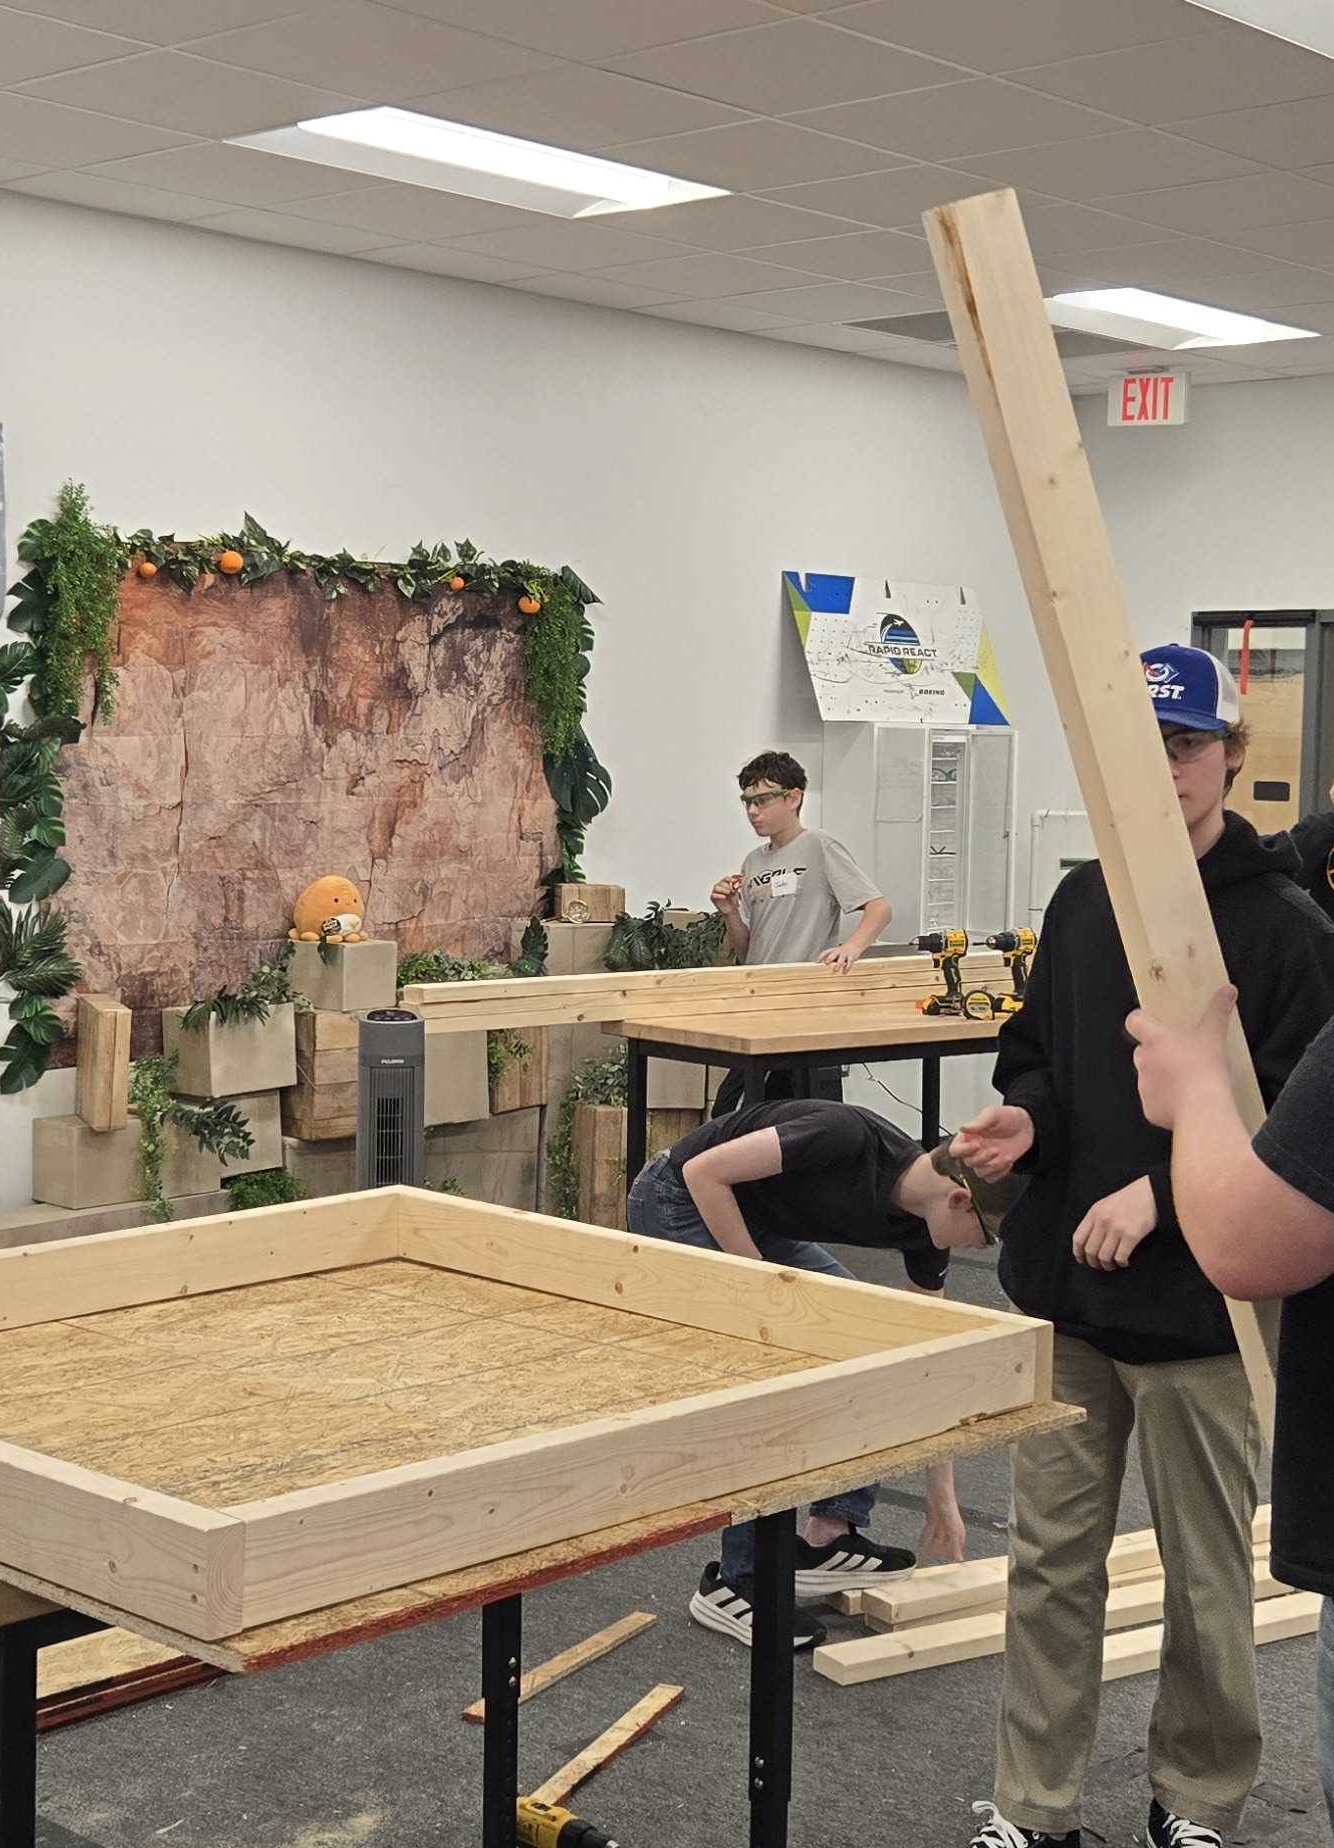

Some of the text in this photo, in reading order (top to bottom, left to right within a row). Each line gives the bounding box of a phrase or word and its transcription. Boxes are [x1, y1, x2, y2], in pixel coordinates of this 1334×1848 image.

[1122, 377, 1174, 421] EXIT
[867, 644, 937, 658] RAPID REACT
[1147, 684, 1185, 699] RST
